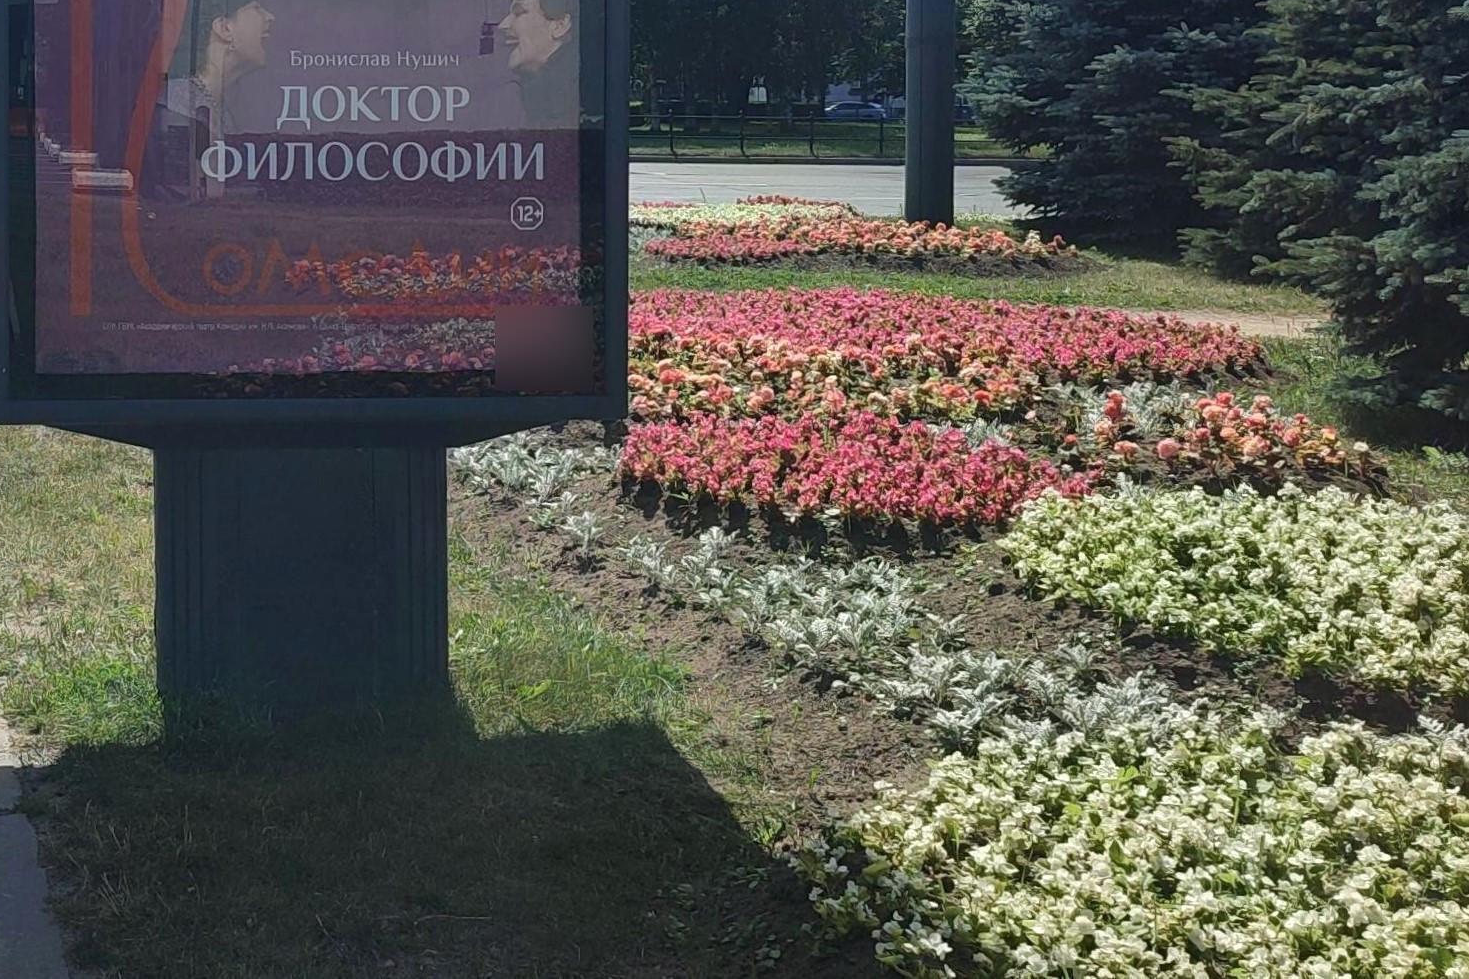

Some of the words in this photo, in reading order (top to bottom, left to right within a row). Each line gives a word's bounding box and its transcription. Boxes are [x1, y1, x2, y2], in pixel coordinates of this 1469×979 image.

[289, 49, 391, 68] Бронислав
[397, 50, 460, 69] Нушич
[276, 85, 471, 130] ДОКТОР
[200, 140, 545, 182] ФИЛОСОФИИ
[516, 204, 543, 222] 12+
